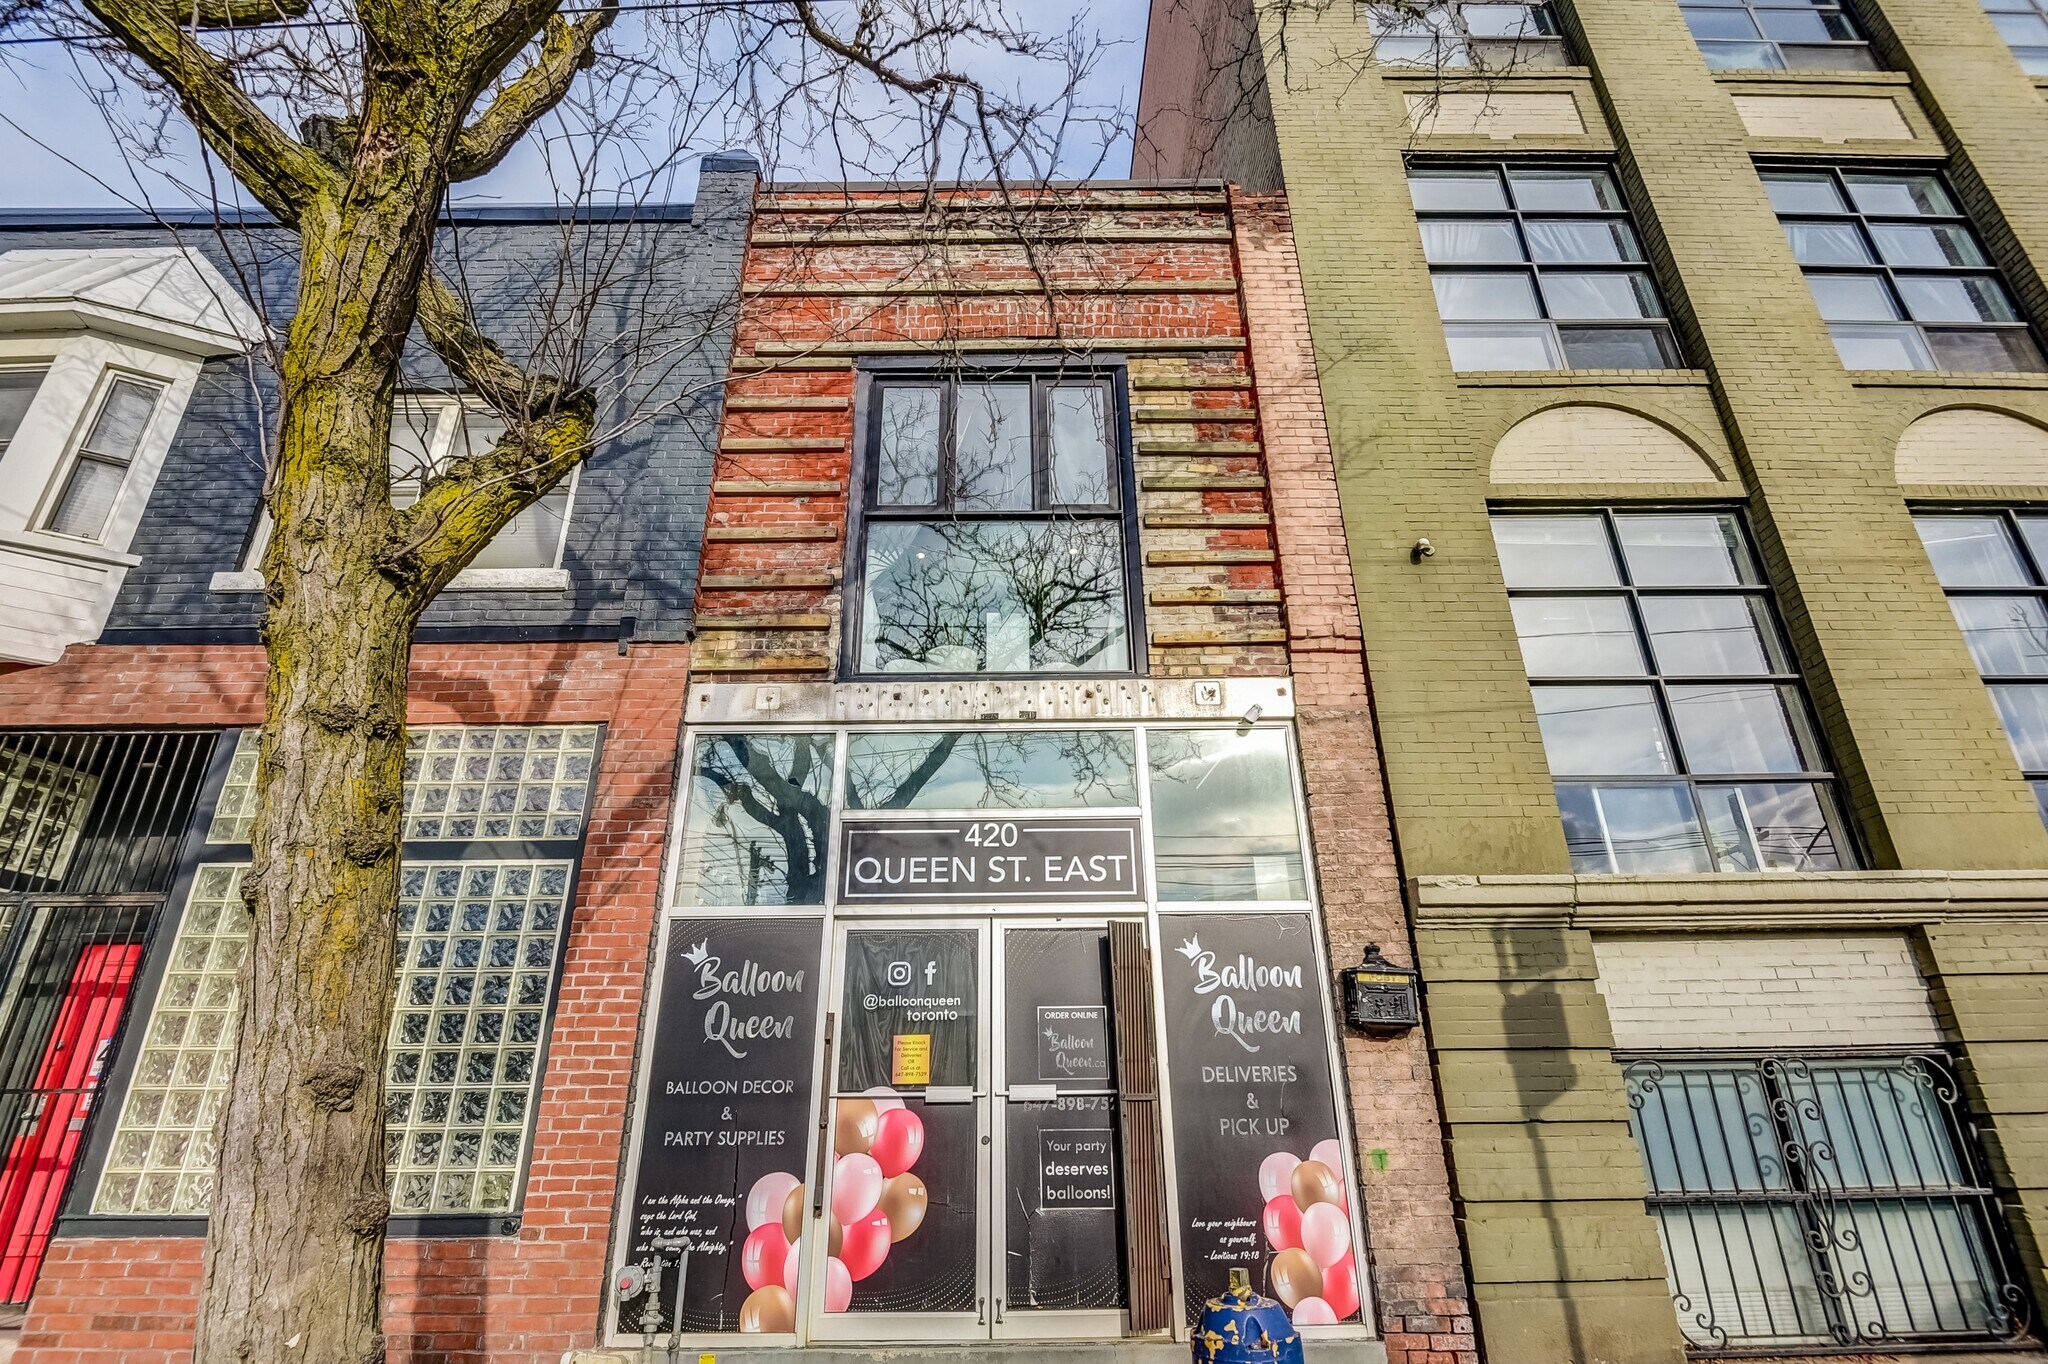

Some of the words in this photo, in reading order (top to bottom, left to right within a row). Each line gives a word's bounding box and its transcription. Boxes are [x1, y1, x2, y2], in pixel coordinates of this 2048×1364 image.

[965, 823, 1018, 847] 420
[854, 857, 976, 885] QUEEN
[988, 856, 1031, 883] ST.
[1044, 855, 1128, 882] EAST
[692, 956, 805, 1000] Balloon
[1190, 950, 1303, 994] Balloon
[863, 993, 961, 1010] @balloonqueen
[907, 1008, 958, 1021] toronto
[1044, 1011, 1070, 1019] ORDER
[1070, 1011, 1098, 1019] ONLINE
[703, 1000, 795, 1059] Queen
[1211, 994, 1302, 1053] Queen
[1049, 1033, 1094, 1052] Balloon
[1055, 1051, 1106, 1075] Queen.ca
[1202, 1066, 1298, 1083] DELIVERIES
[665, 1080, 738, 1095] BALLOON
[742, 1080, 794, 1094] DECOR
[1246, 1092, 1259, 1109] &
[720, 1106, 733, 1120] &
[1219, 1118, 1261, 1136] PICK
[1266, 1117, 1290, 1136] UP
[664, 1131, 714, 1146] PARTY
[717, 1130, 786, 1146] SUPPLIES
[1046, 1140, 1072, 1152] Your
[1075, 1140, 1107, 1154] party
[1045, 1161, 1109, 1176] deserves
[1046, 1185, 1111, 1200] balloons!
[642, 1194, 649, 1205] I
[658, 1195, 668, 1205] the
[669, 1194, 688, 1208] Alpha
[690, 1194, 703, 1205] and
[702, 1194, 713, 1205] the
[640, 1213, 655, 1223] says
[656, 1210, 666, 1220] the
[668, 1210, 685, 1220] Lord
[684, 1209, 698, 1222] God,
[664, 1226, 677, 1235] and
[676, 1226, 688, 1235] who
[689, 1228, 702, 1237] was,
[705, 1226, 718, 1235] and
[1191, 1217, 1206, 1228] Love
[1206, 1220, 1222, 1231] your
[1224, 1217, 1257, 1231] neighbours
[636, 1242, 649, 1251] who
[1227, 1232, 1257, 1247] yourself.
[1210, 1250, 1238, 1260] Leviticus
[1240, 1251, 1260, 1260] 19:18
